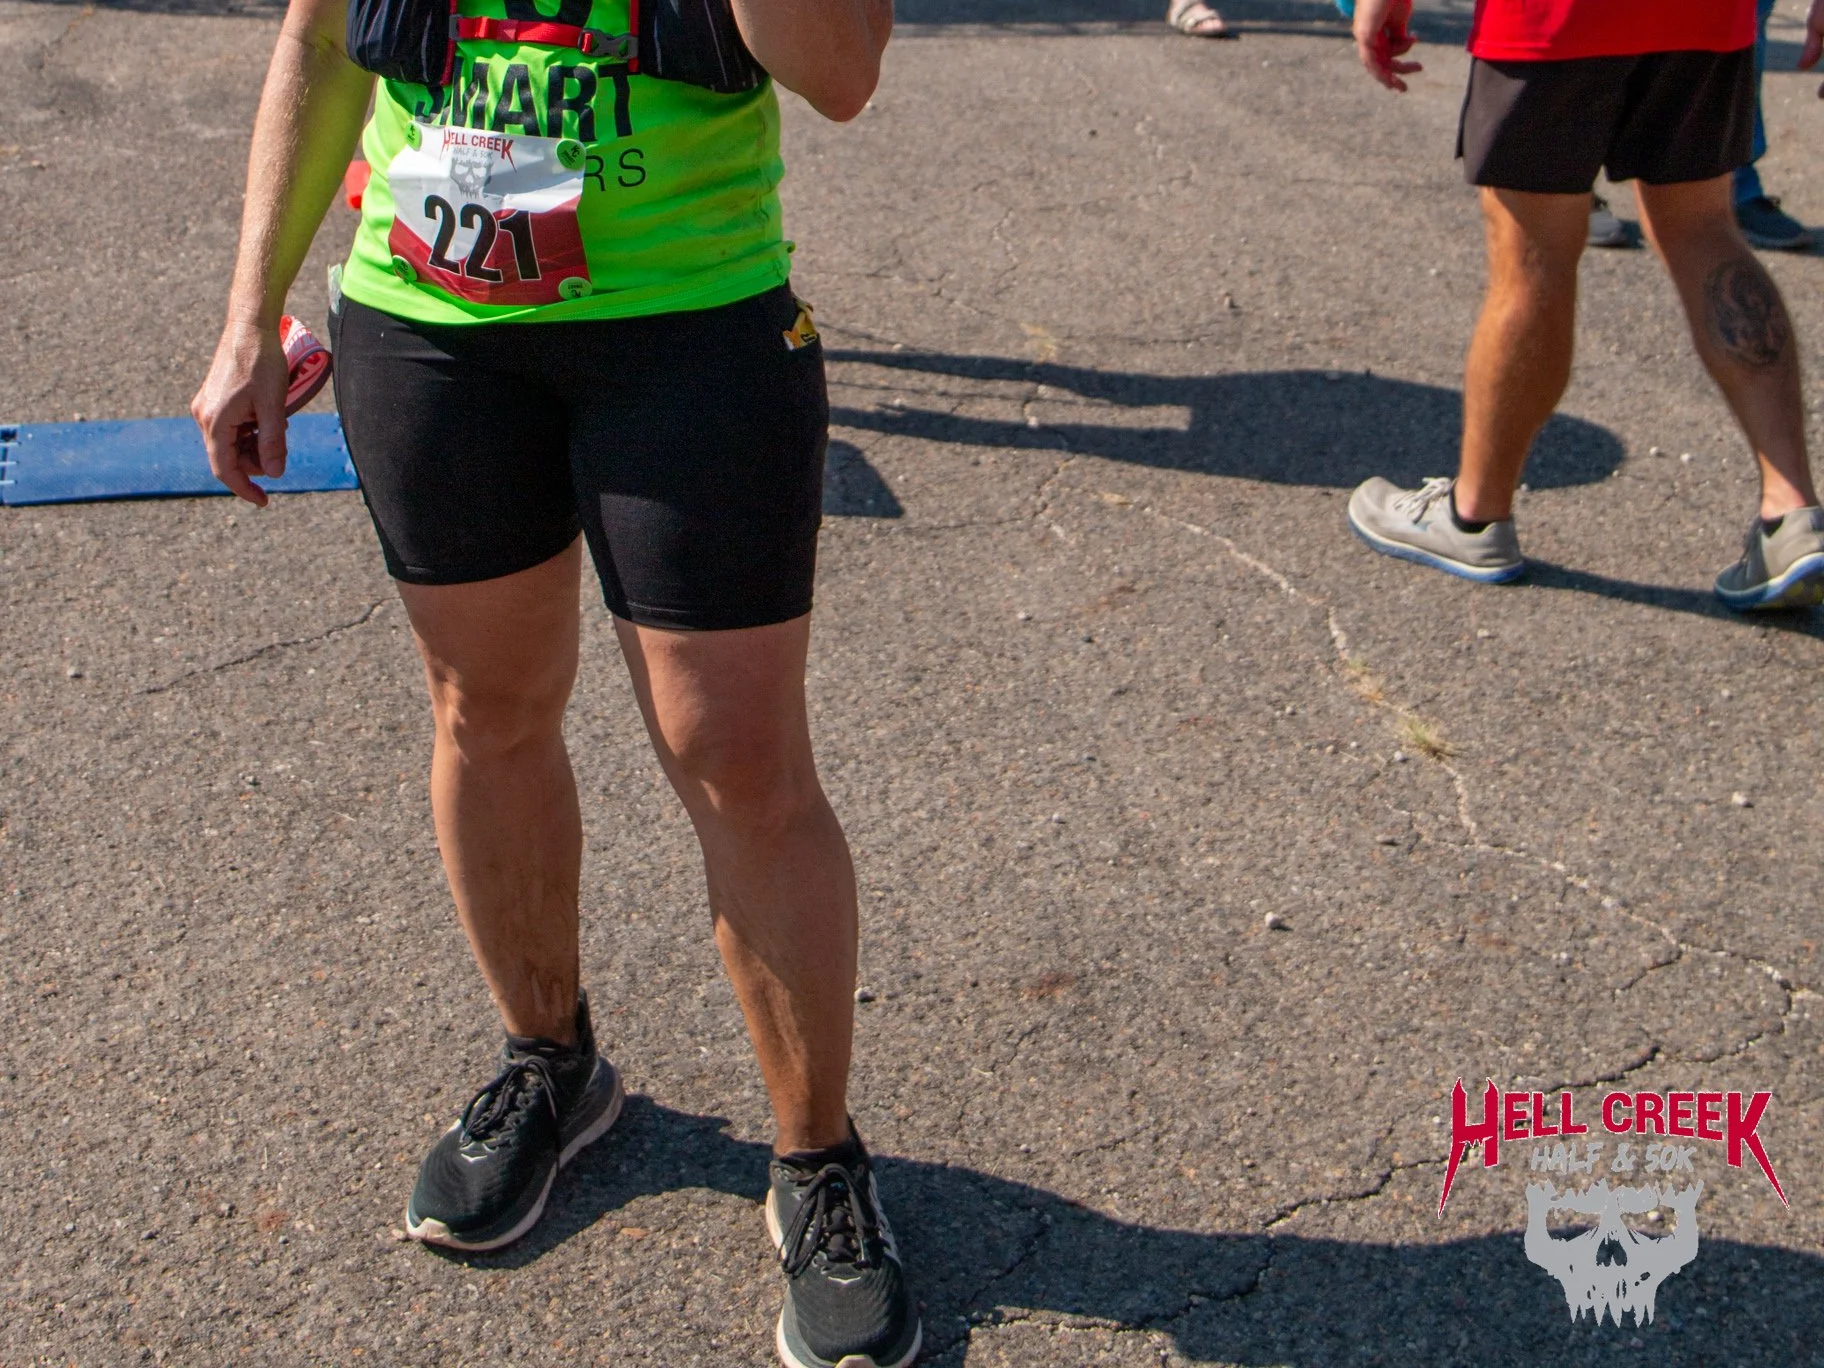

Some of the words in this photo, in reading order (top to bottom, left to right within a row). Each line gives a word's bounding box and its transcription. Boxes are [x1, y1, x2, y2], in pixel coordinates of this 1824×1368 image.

[440, 126, 468, 160] HELL
[472, 135, 517, 173] CREEK
[425, 194, 542, 282] 221
